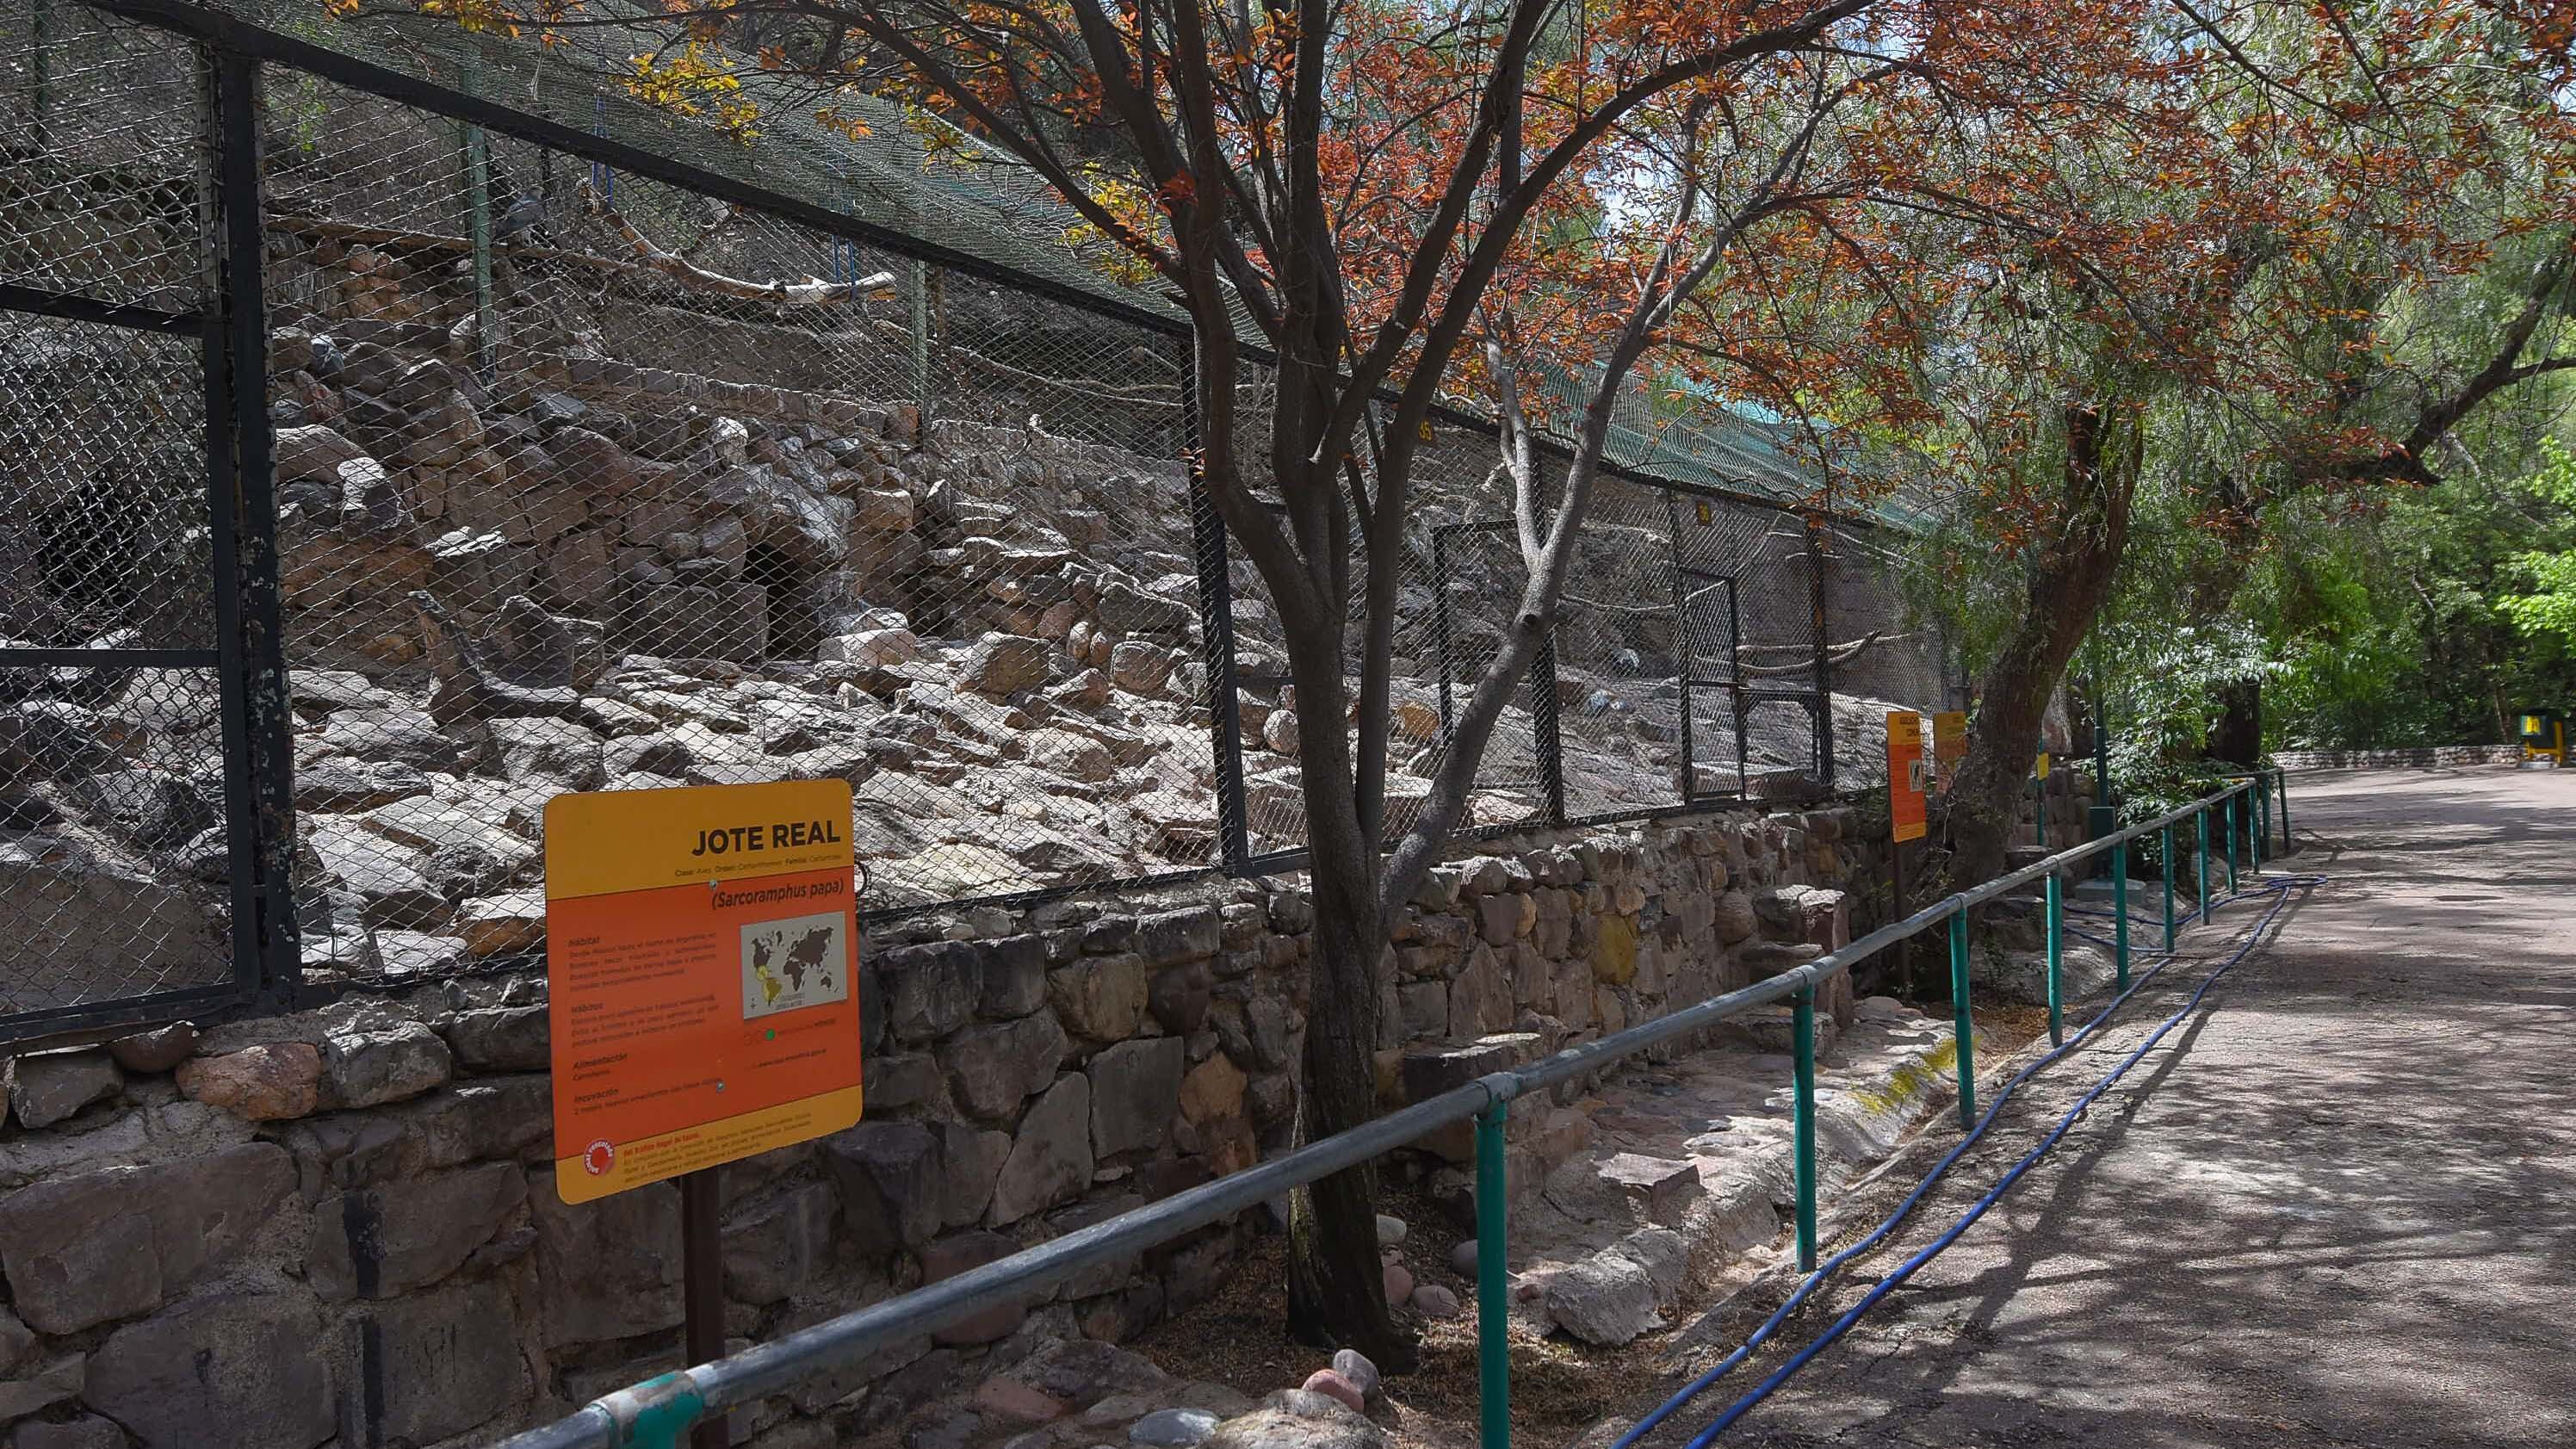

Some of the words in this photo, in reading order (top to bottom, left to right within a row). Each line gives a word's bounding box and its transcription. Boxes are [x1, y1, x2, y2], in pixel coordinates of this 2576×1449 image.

[691, 826, 764, 856] JOTE
[771, 820, 841, 848] REAL
[712, 882, 807, 911] (Sarcoramphus
[809, 876, 845, 900] papa)
[572, 1051, 628, 1070] Alimentación
